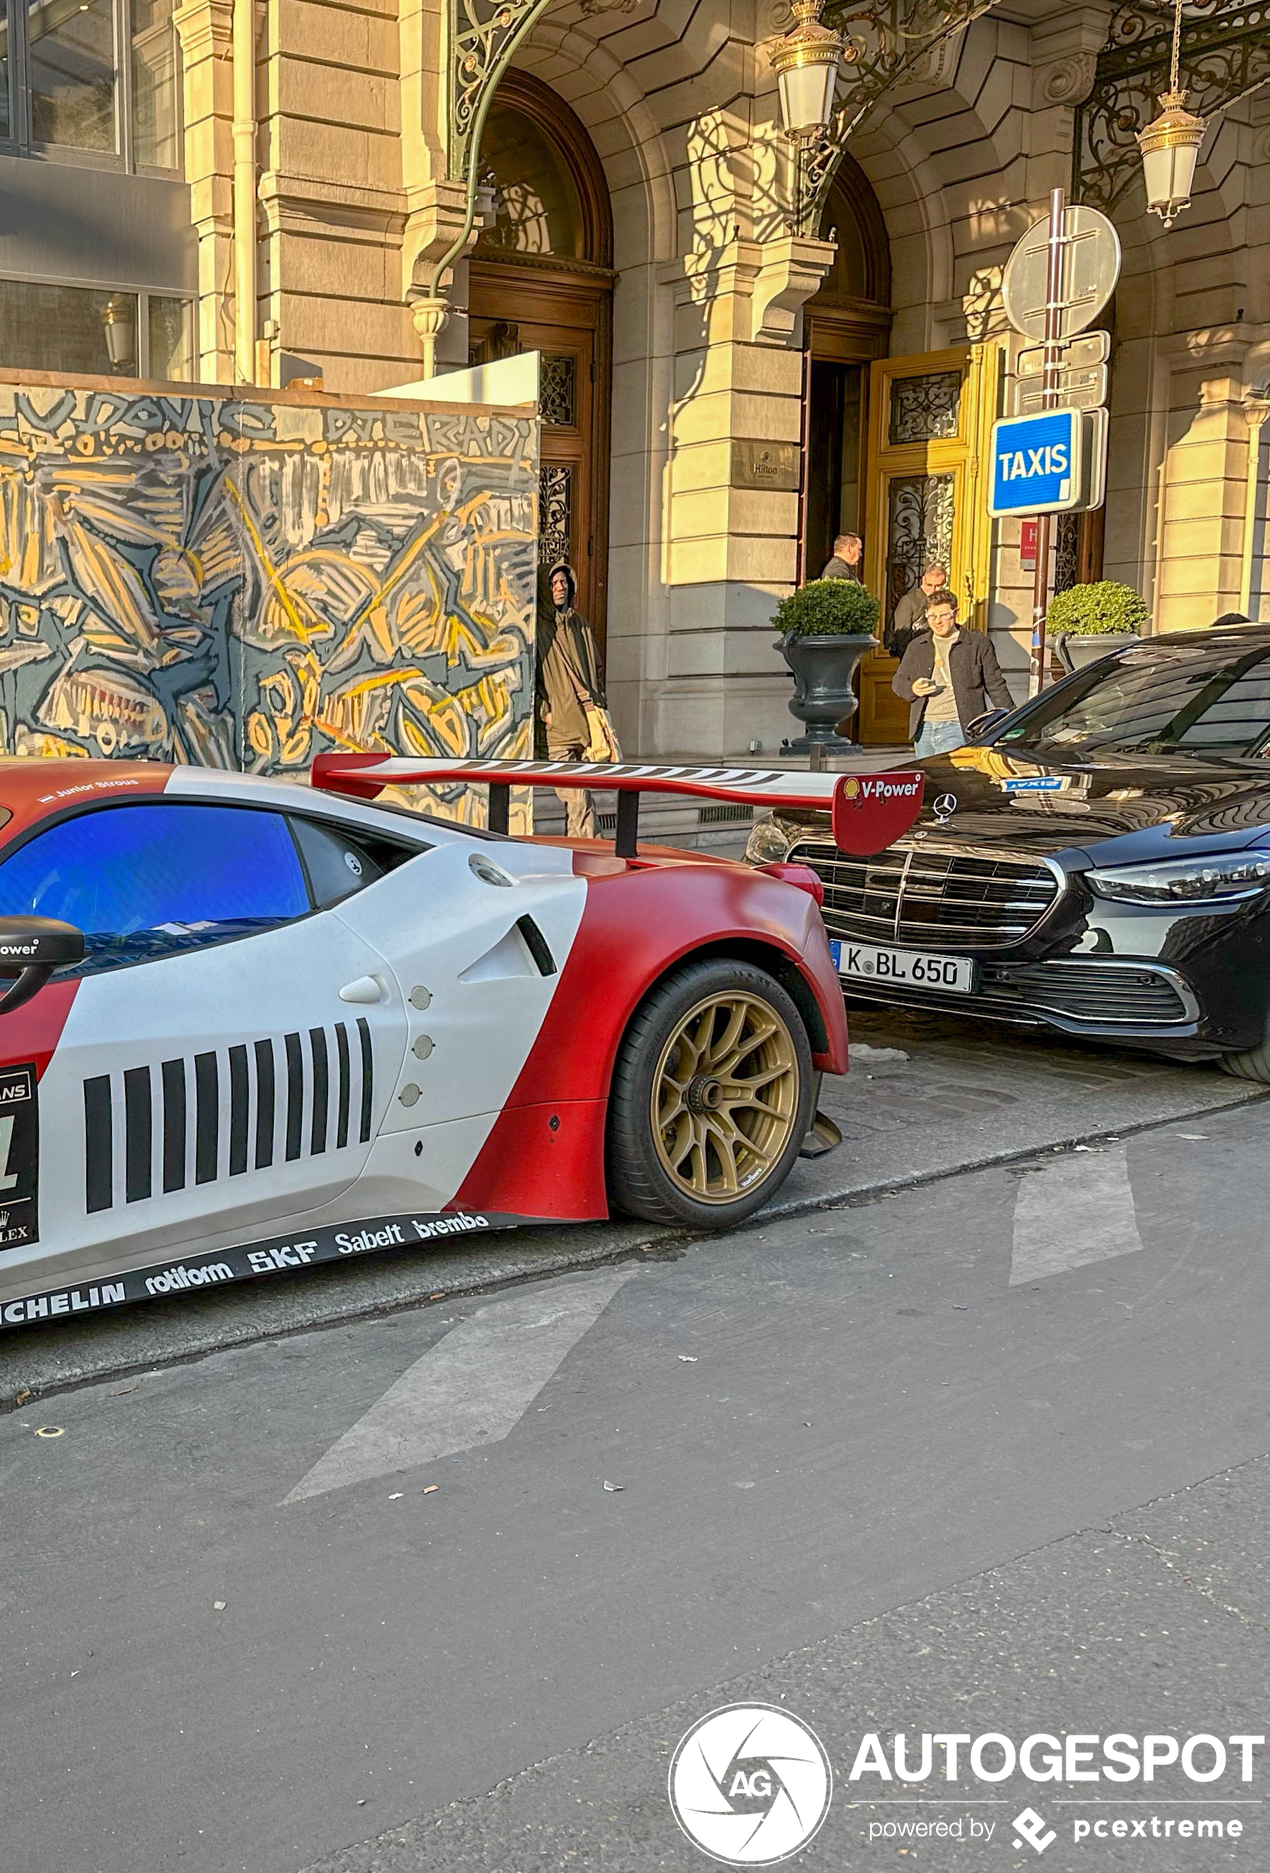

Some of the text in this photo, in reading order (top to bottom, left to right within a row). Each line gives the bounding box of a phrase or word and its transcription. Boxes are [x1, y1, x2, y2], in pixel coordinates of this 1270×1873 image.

[755, 463, 778, 475] Hilton
[998, 443, 1068, 482] TAXIS
[56, 779, 139, 797] Junior Strous
[861, 780, 919, 798] V-Power
[847, 947, 958, 985] K BL 650
[145, 1262, 235, 1295] rotiform
[247, 1241, 318, 1273] SKF
[335, 1223, 406, 1255] Sabelt
[412, 1211, 490, 1240] brembo
